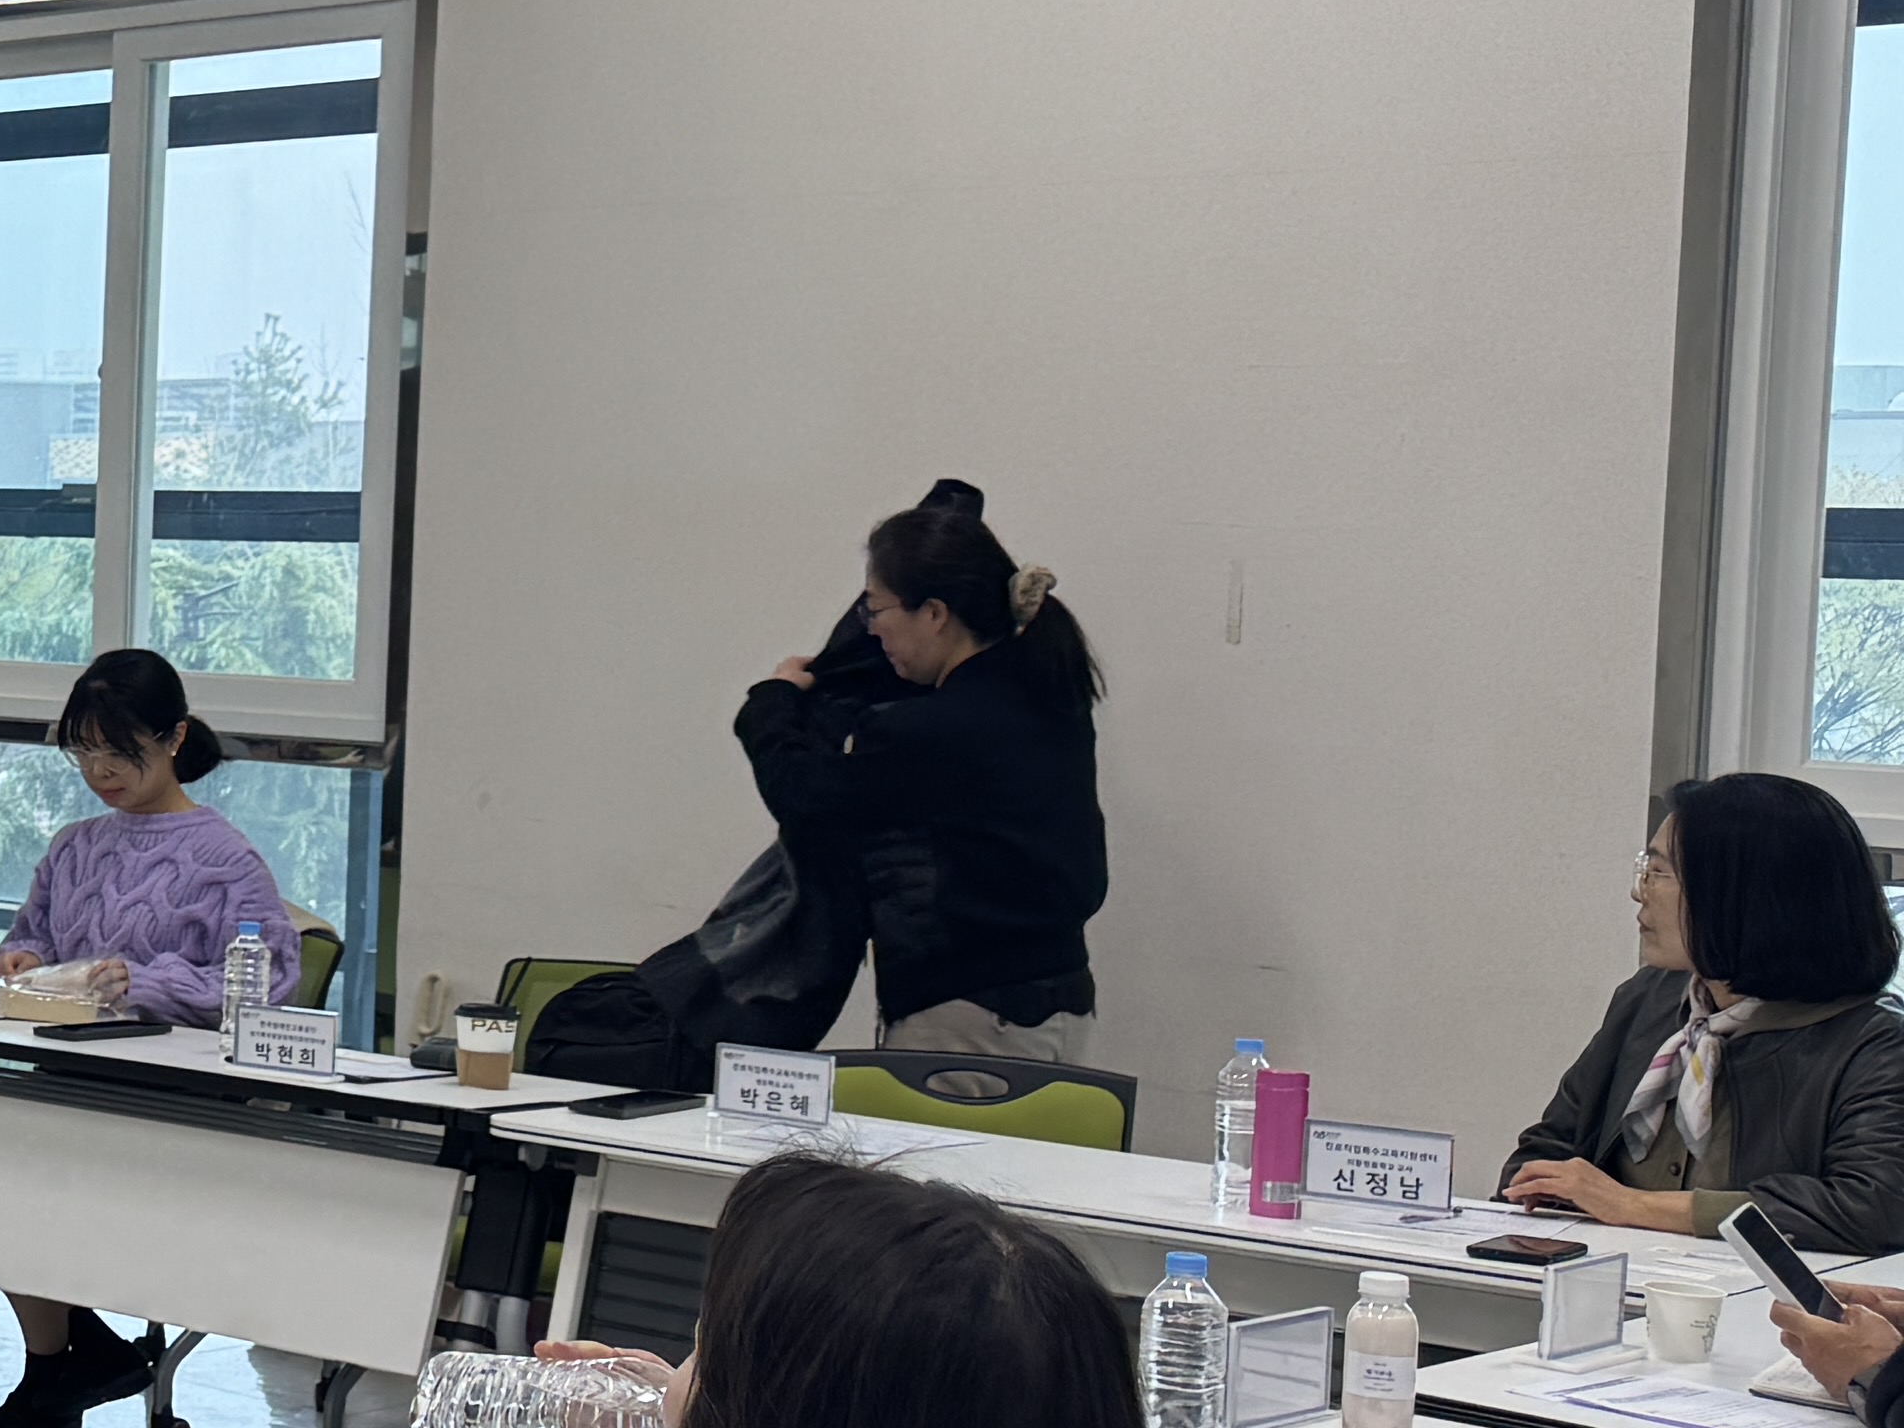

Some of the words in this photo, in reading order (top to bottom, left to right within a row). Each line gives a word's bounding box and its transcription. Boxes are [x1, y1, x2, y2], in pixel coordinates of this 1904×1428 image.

[255, 1043, 316, 1067] 박현희
[740, 1088, 809, 1116] 박은혜
[1333, 1168, 1423, 1200] 신정남
